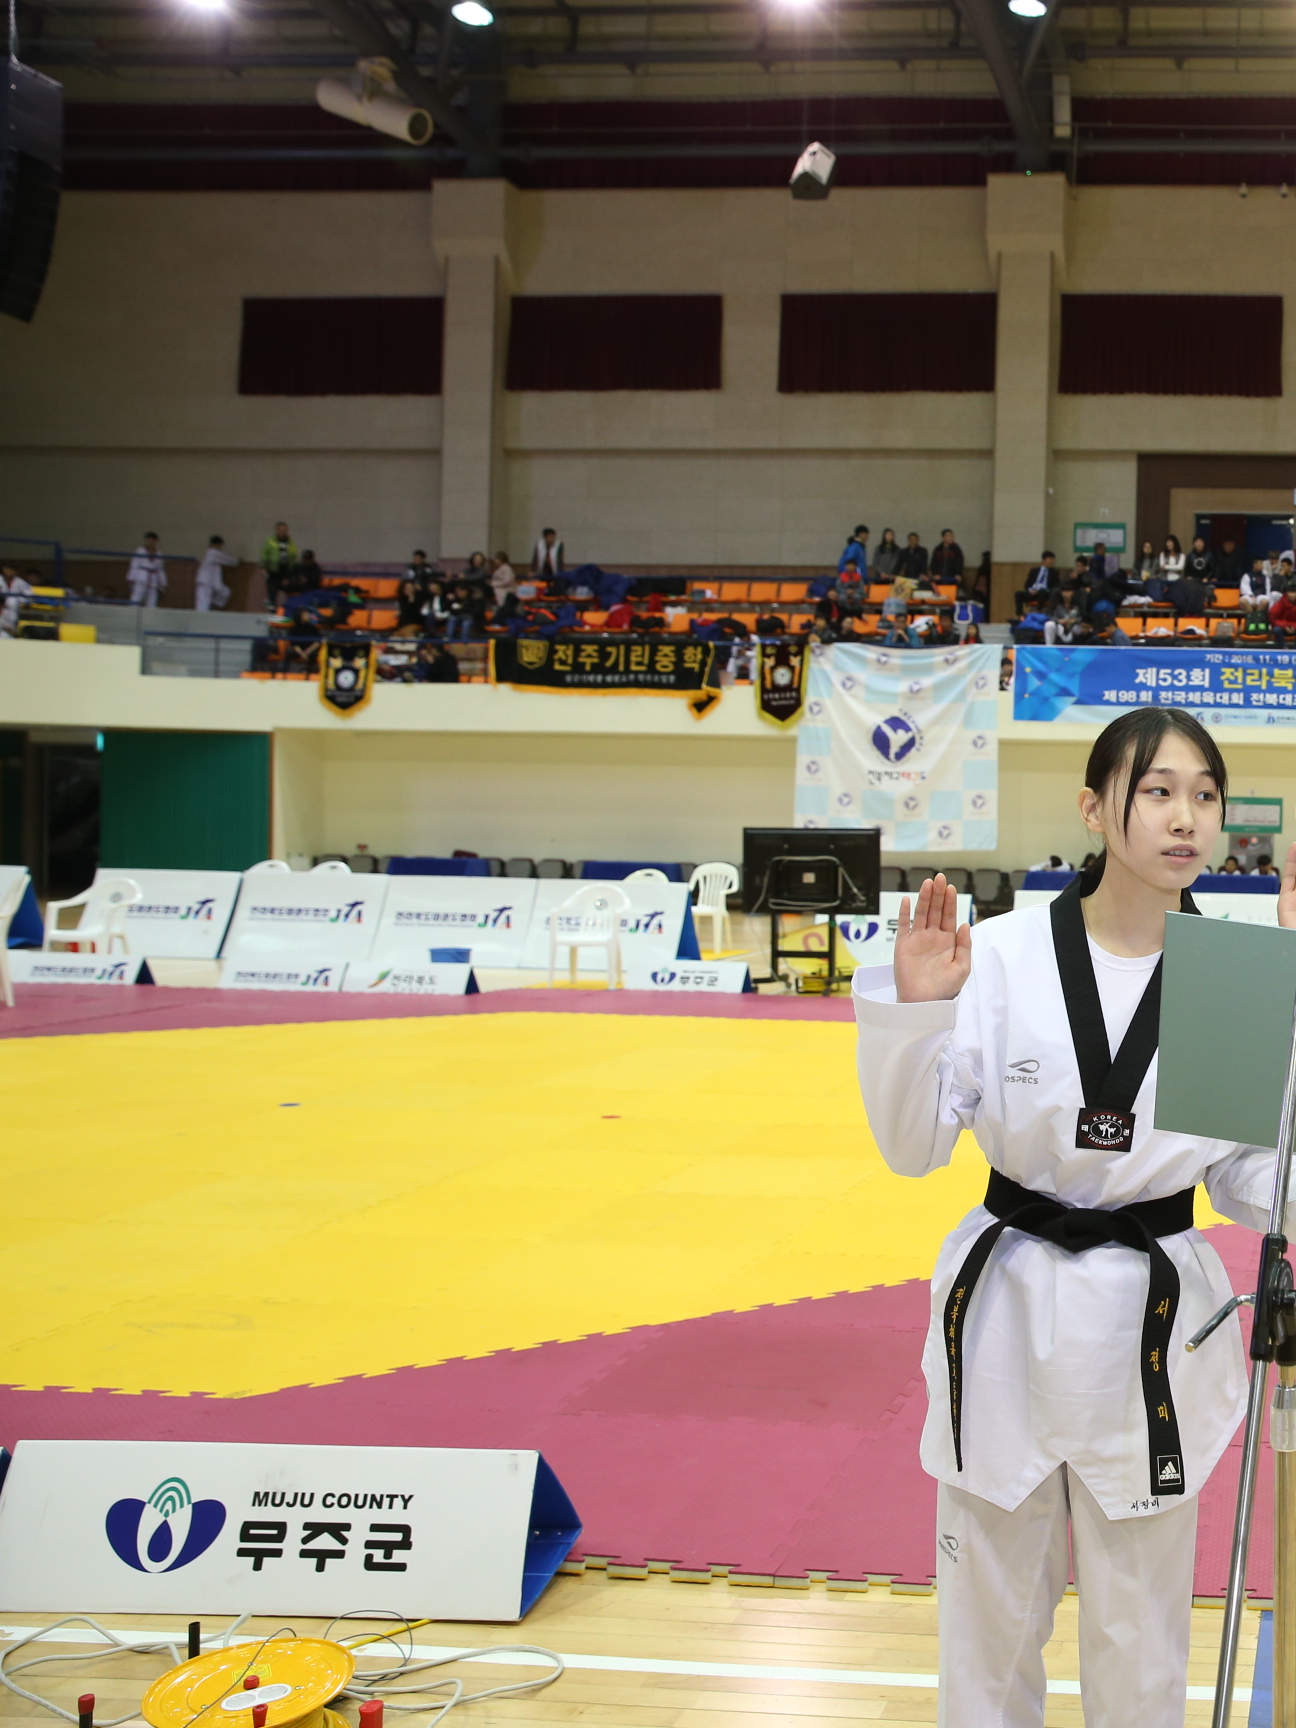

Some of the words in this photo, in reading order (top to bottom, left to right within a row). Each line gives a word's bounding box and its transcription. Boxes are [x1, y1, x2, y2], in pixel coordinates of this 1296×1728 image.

[1135, 667, 1210, 689] 제53회
[1102, 689, 1152, 703] 제98회
[1158, 691, 1244, 705] 전국체육대회
[1093, 1114, 1123, 1125] KOREA
[1087, 1133, 1124, 1146] TAEKWONDO
[1159, 1473, 1180, 1481] adidas
[251, 1491, 315, 1509] MUJU
[320, 1492, 415, 1511] COUNTY
[236, 1520, 413, 1573] 무주군
